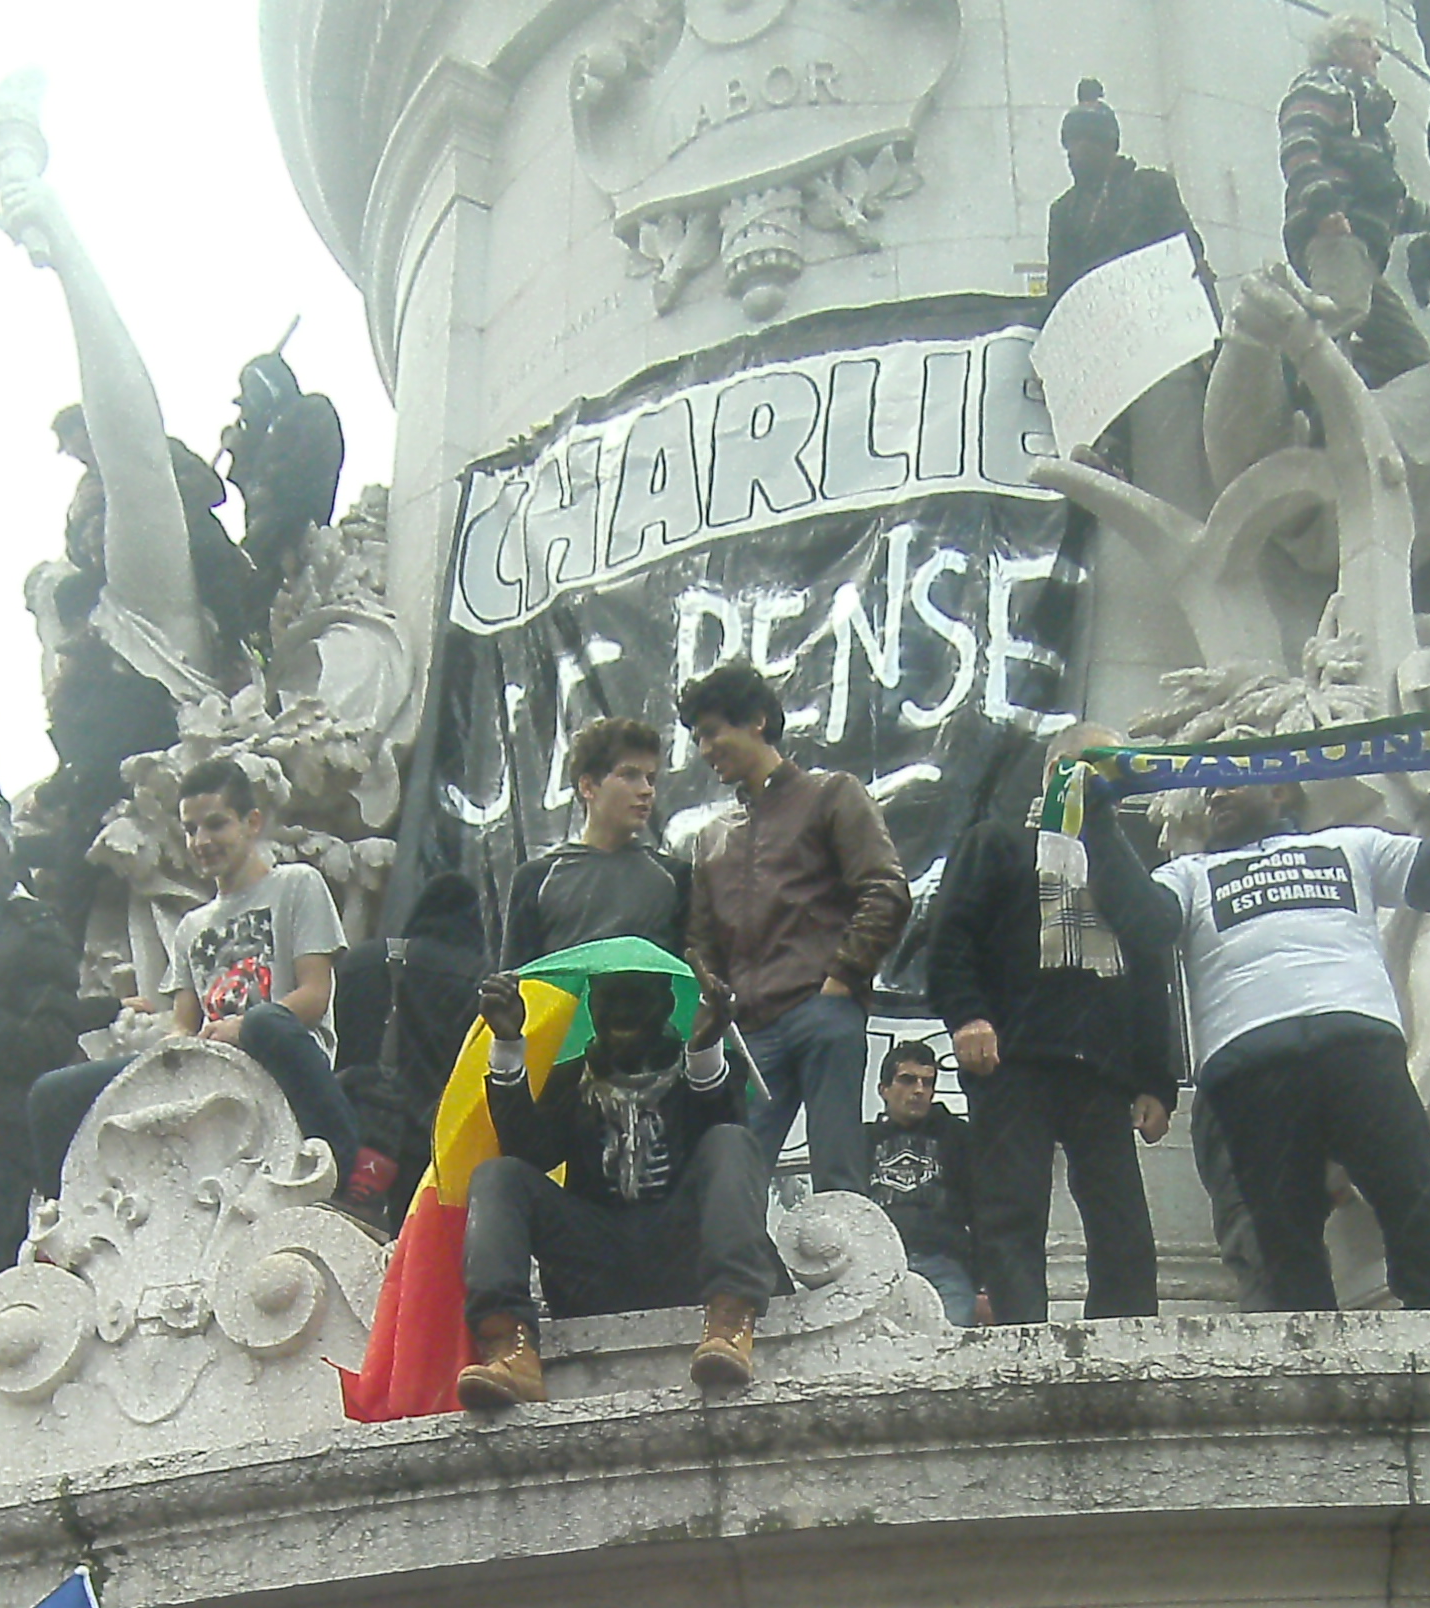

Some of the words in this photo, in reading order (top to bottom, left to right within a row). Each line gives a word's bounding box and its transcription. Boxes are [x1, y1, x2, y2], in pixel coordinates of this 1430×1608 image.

[457, 334, 1061, 623] CHARLIE
[665, 520, 1077, 776] PENSE
[1115, 729, 1425, 779] GABON
[1231, 890, 1263, 914] EST
[1266, 883, 1341, 902] CHARLIE
